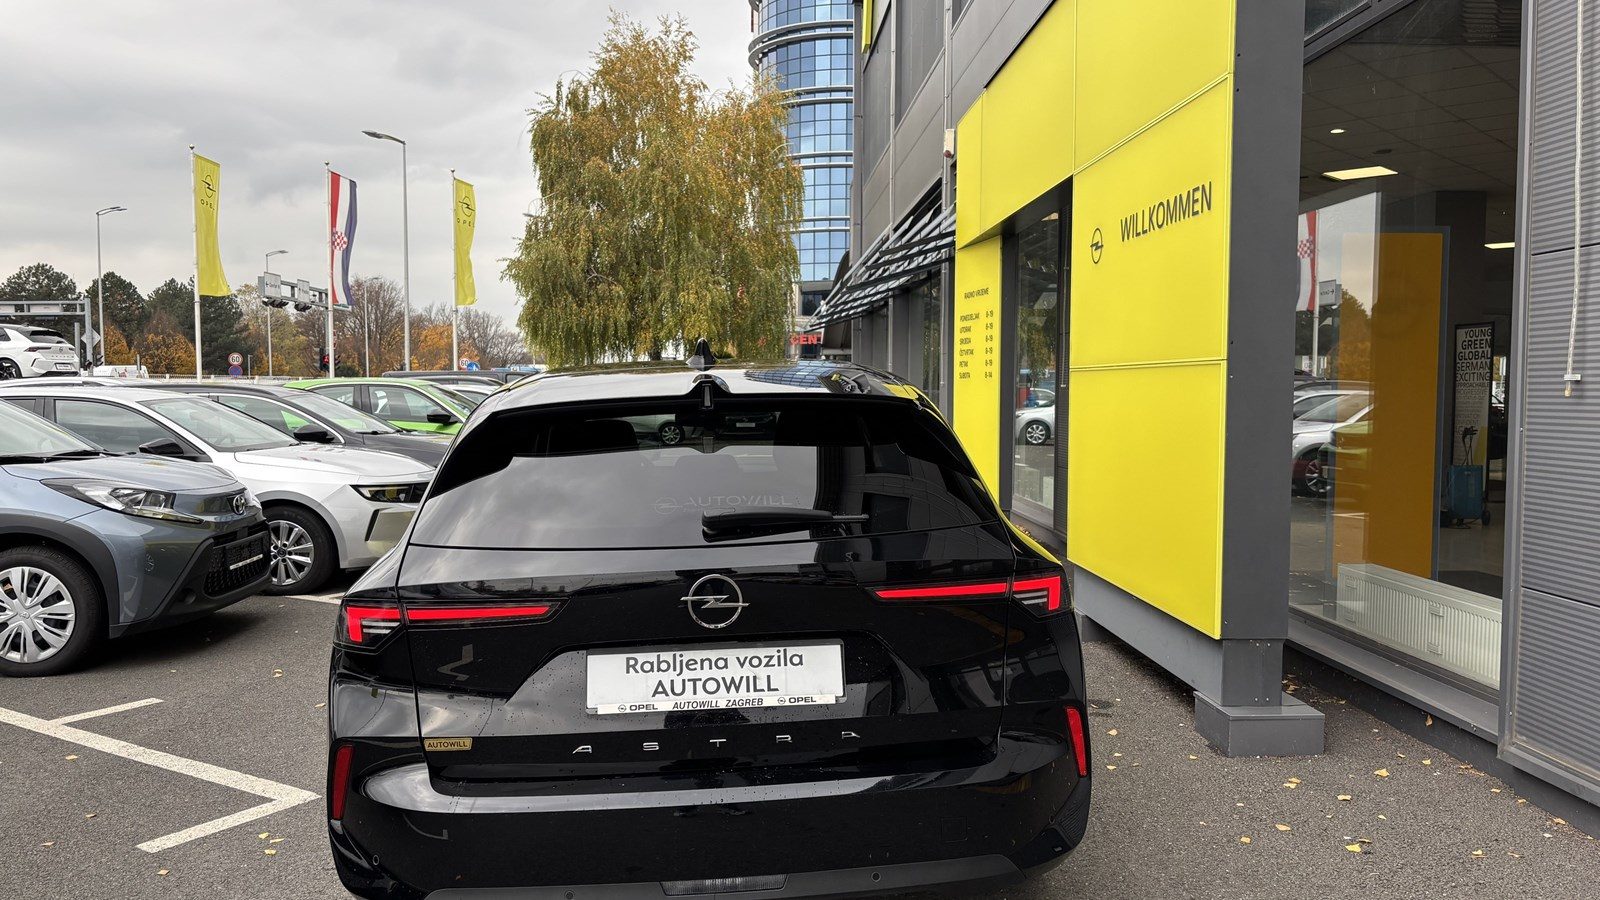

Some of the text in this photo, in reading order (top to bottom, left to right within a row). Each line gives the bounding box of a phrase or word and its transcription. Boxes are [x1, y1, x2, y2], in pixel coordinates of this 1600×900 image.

[1120, 181, 1212, 242] WILLKOMMEN
[1465, 328, 1492, 339] YOUNG
[1461, 338, 1491, 351] GREEN
[231, 355, 240, 363] 60
[1457, 350, 1491, 361] GLOBAL
[460, 359, 469, 367] 60
[1456, 361, 1491, 372] GERMAN
[1456, 371, 1490, 382] EXCITING
[684, 495, 793, 507] AUTOWILL
[625, 648, 804, 676] Rabljena vozila
[651, 674, 780, 698] AUTOWILL
[629, 696, 817, 711] OPEL AUTOWILL ZAGREB OPEL
[572, 731, 861, 754] ASTRA
